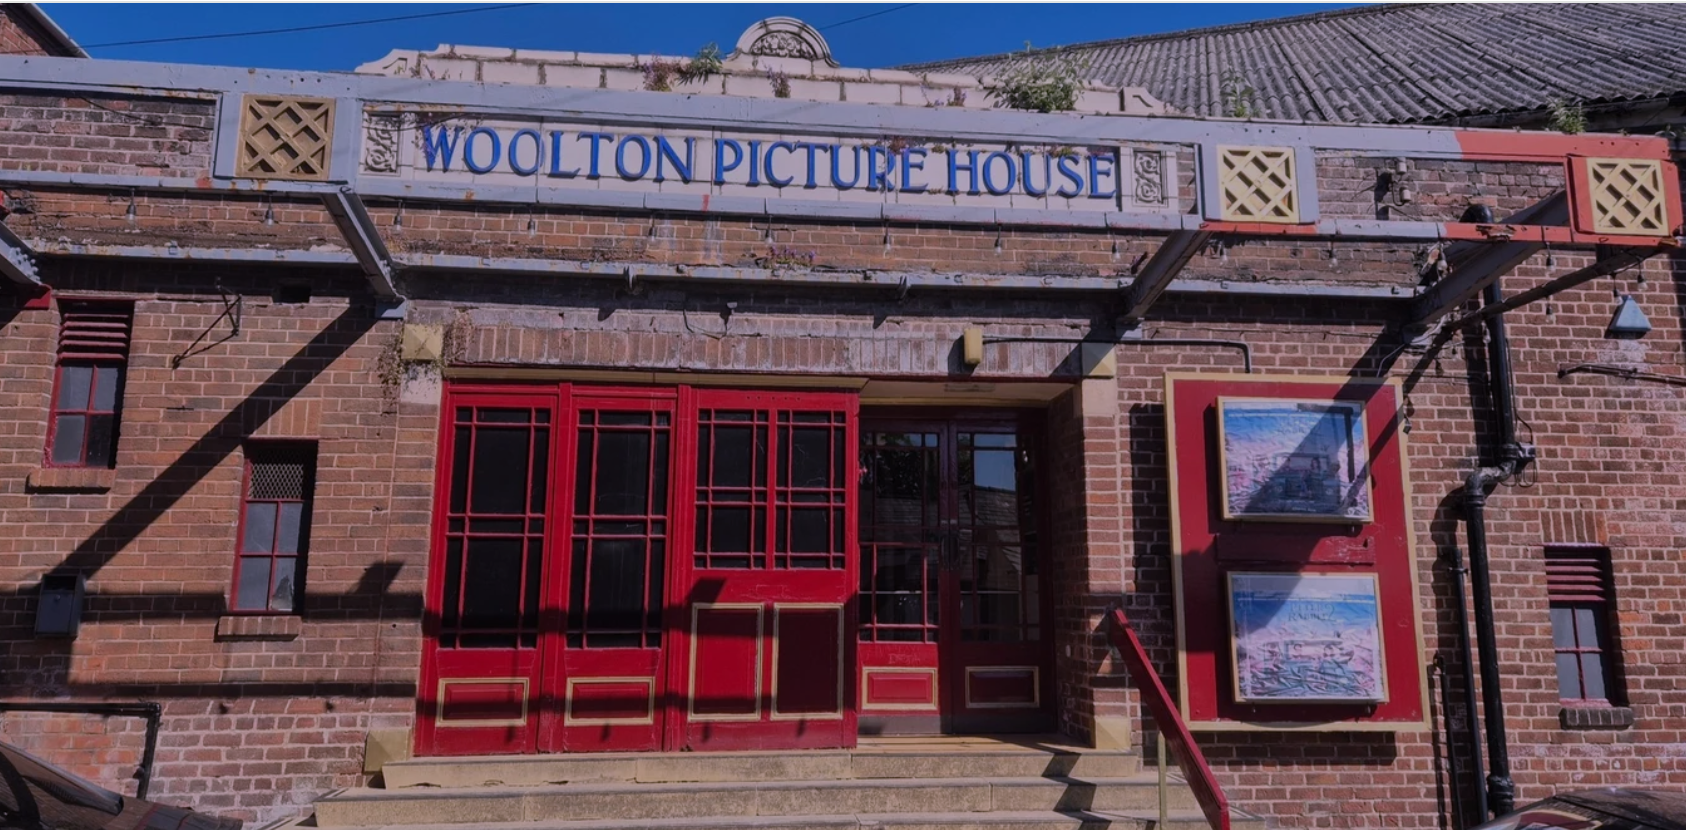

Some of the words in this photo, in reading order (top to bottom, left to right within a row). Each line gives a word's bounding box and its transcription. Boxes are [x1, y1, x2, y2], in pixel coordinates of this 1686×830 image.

[422, 124, 694, 184] WOOLTON
[713, 138, 928, 192] PICTURE
[946, 148, 1117, 199] HOUSE
